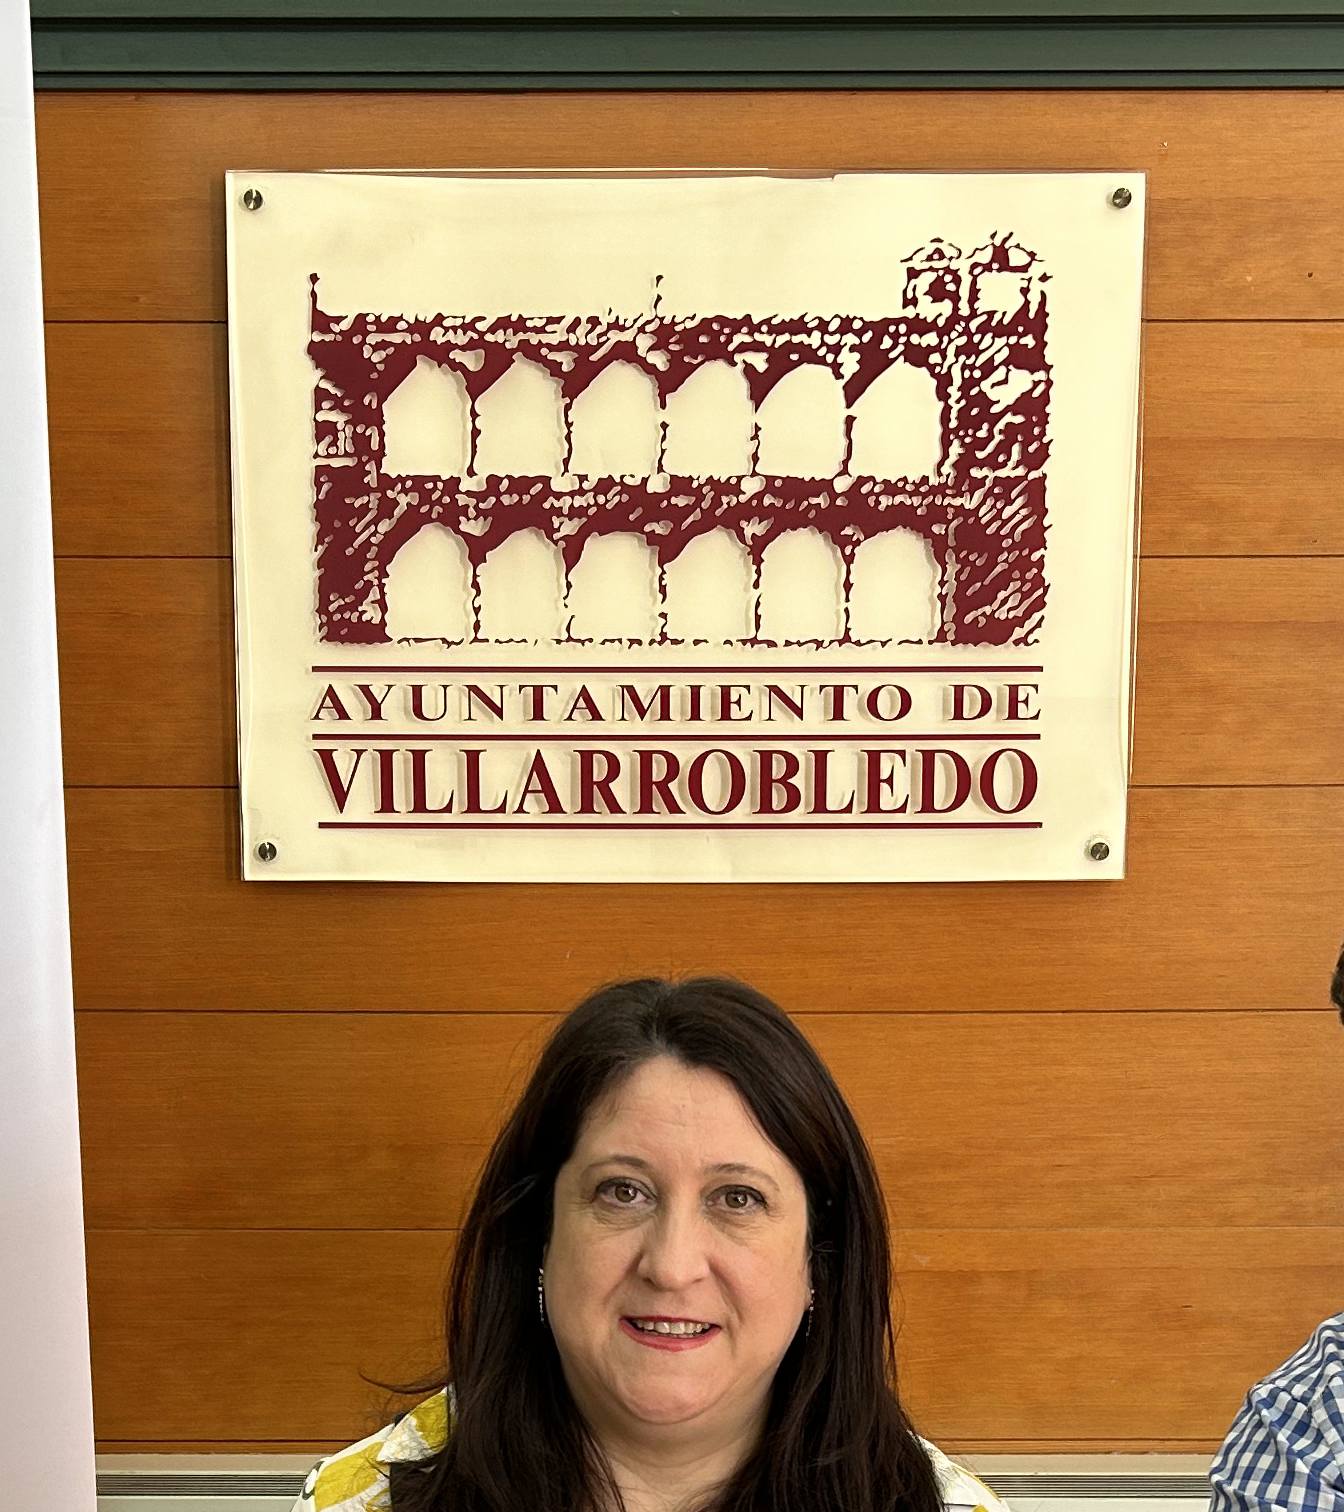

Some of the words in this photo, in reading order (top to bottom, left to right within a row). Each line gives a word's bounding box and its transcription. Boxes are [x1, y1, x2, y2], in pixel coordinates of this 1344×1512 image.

[312, 683, 913, 722] AYUNTAMIENTO
[949, 683, 1042, 722] DE
[312, 747, 1039, 816] VILLARROBLEDO
